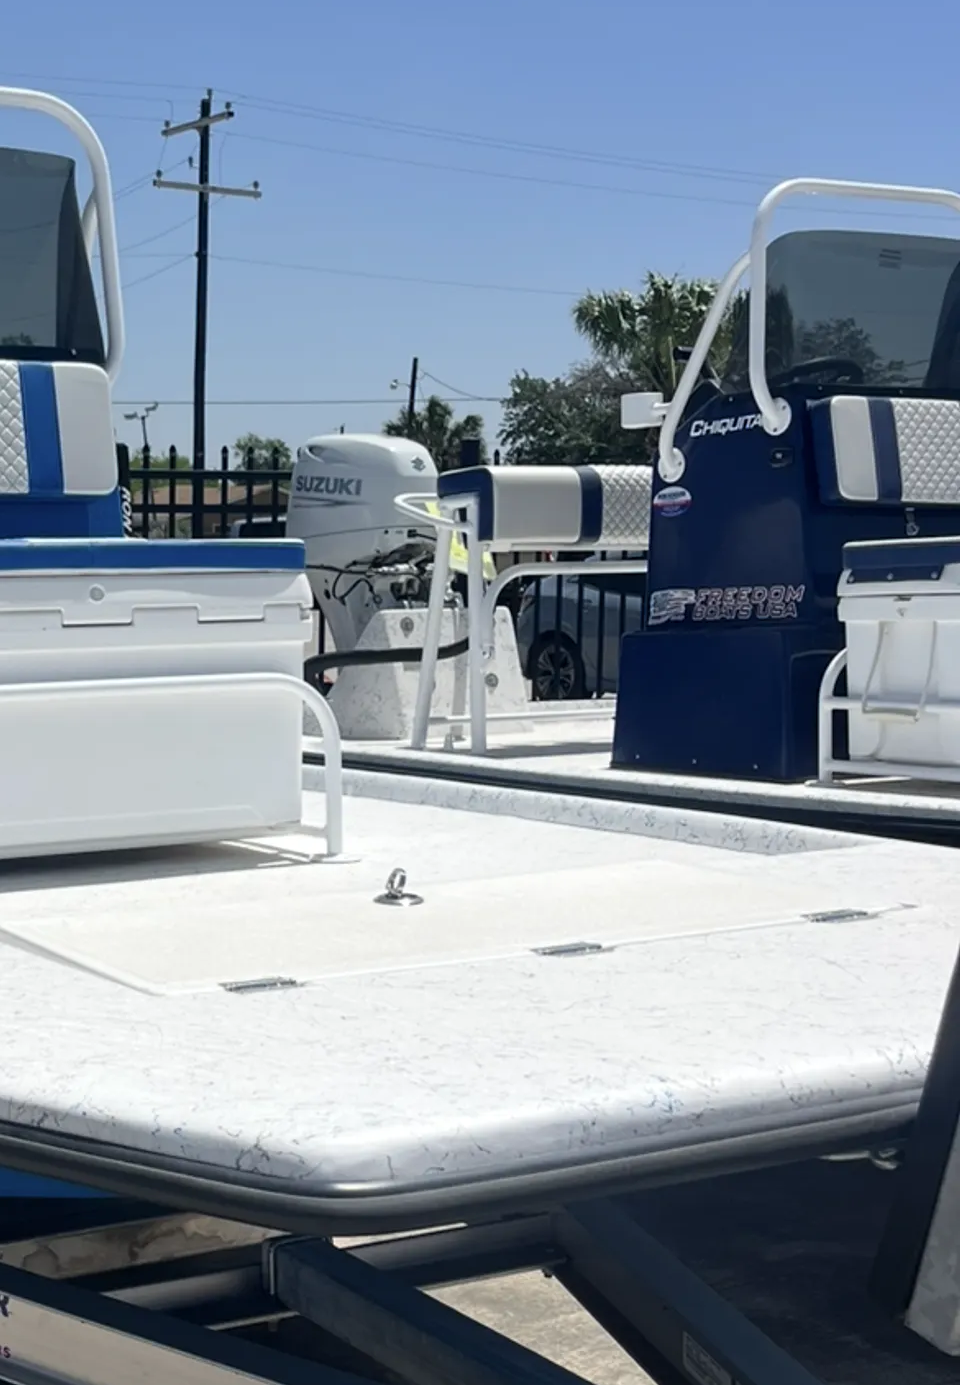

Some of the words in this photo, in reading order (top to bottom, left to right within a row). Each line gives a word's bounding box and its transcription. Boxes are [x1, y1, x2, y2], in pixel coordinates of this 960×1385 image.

[690, 414, 764, 437] CHIQUITA
[296, 475, 362, 495] SUZUKI
[695, 584, 805, 606] FREEDOM
[692, 603, 753, 621] BOATS
[756, 601, 797, 619] USA
